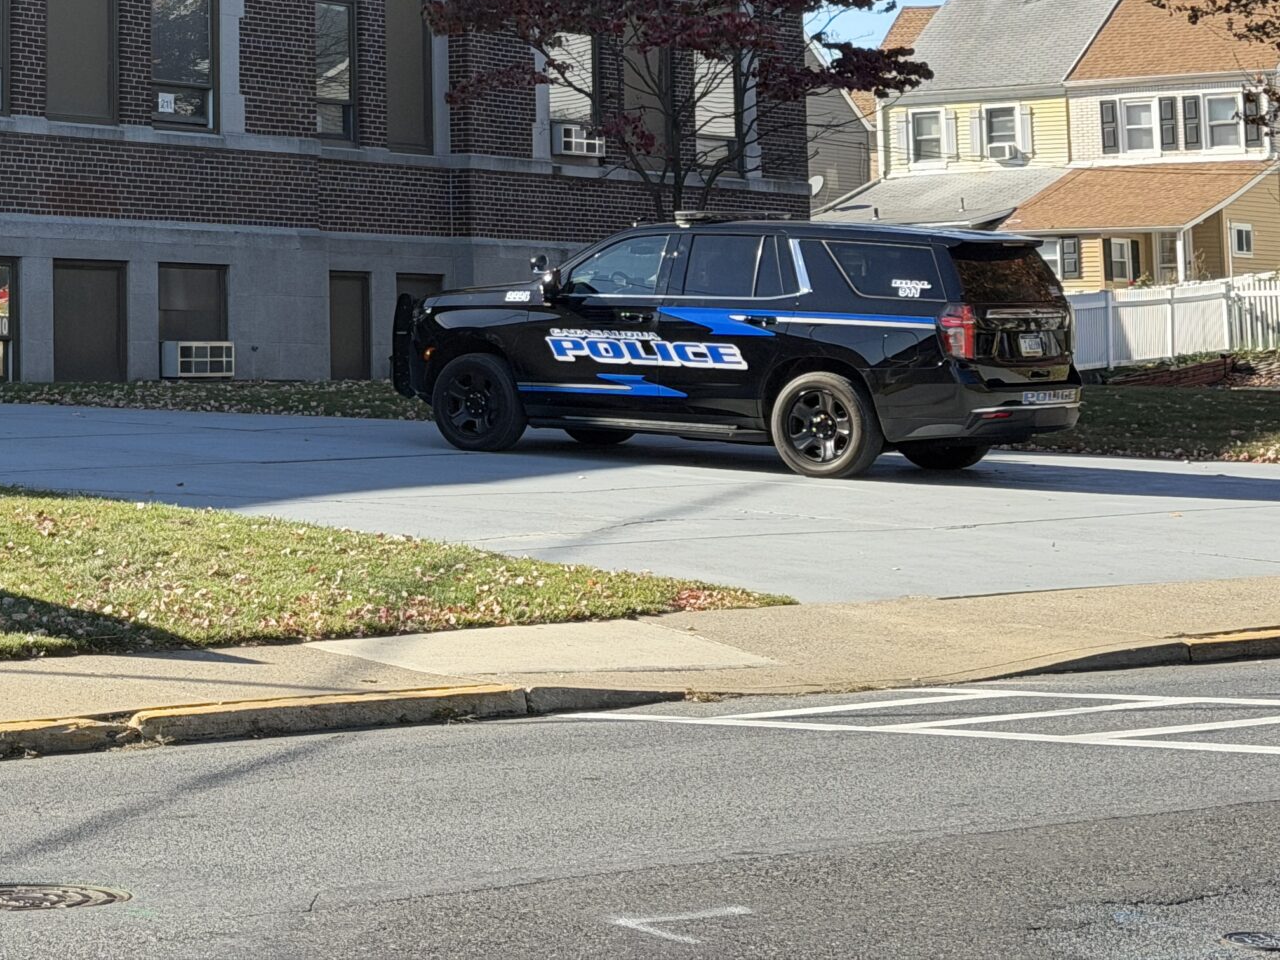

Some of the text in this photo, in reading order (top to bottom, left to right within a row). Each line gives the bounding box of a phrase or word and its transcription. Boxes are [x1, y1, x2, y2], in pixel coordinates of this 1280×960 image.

[160, 98, 173, 109] 211
[899, 287, 920, 298] 911
[545, 336, 749, 370] POLICE
[1022, 389, 1077, 404] POLICE
